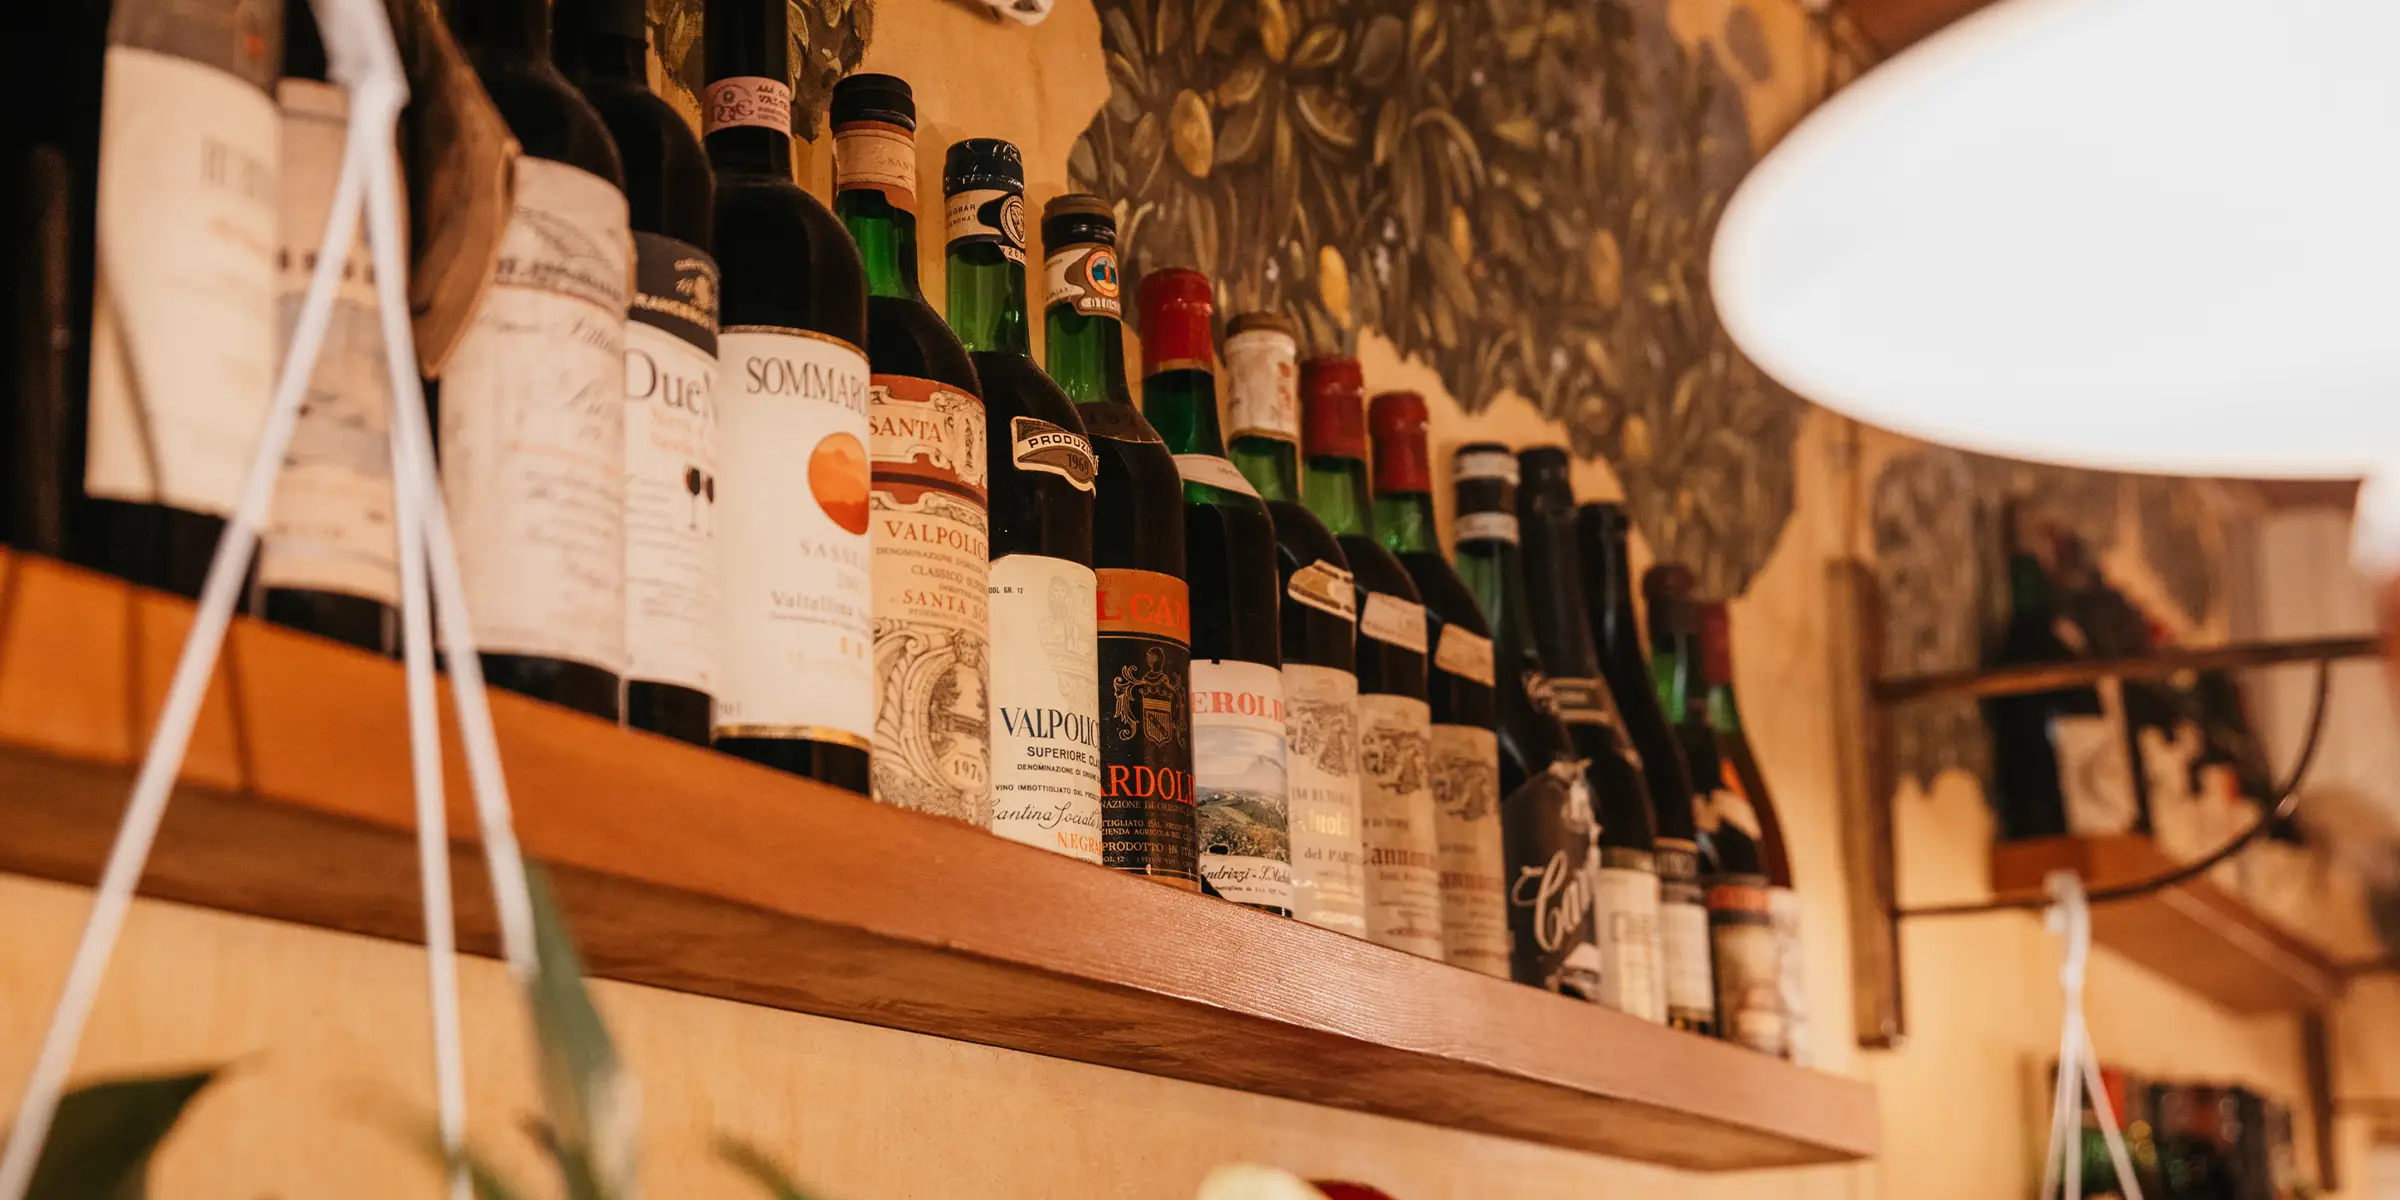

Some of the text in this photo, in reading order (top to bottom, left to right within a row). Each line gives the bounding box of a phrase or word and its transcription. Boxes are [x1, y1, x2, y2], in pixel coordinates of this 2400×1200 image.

[869, 415, 943, 444] SANTA
[911, 563, 963, 584] CLASSICO
[902, 589, 967, 616] SANTA
[1027, 746, 1087, 764] SUPERIORE
[1017, 763, 1075, 776] DENOMINAZIONE
[1017, 784, 1072, 795] IMBOTTIGLIATO
[1103, 841, 1164, 852] PRODOTTO
